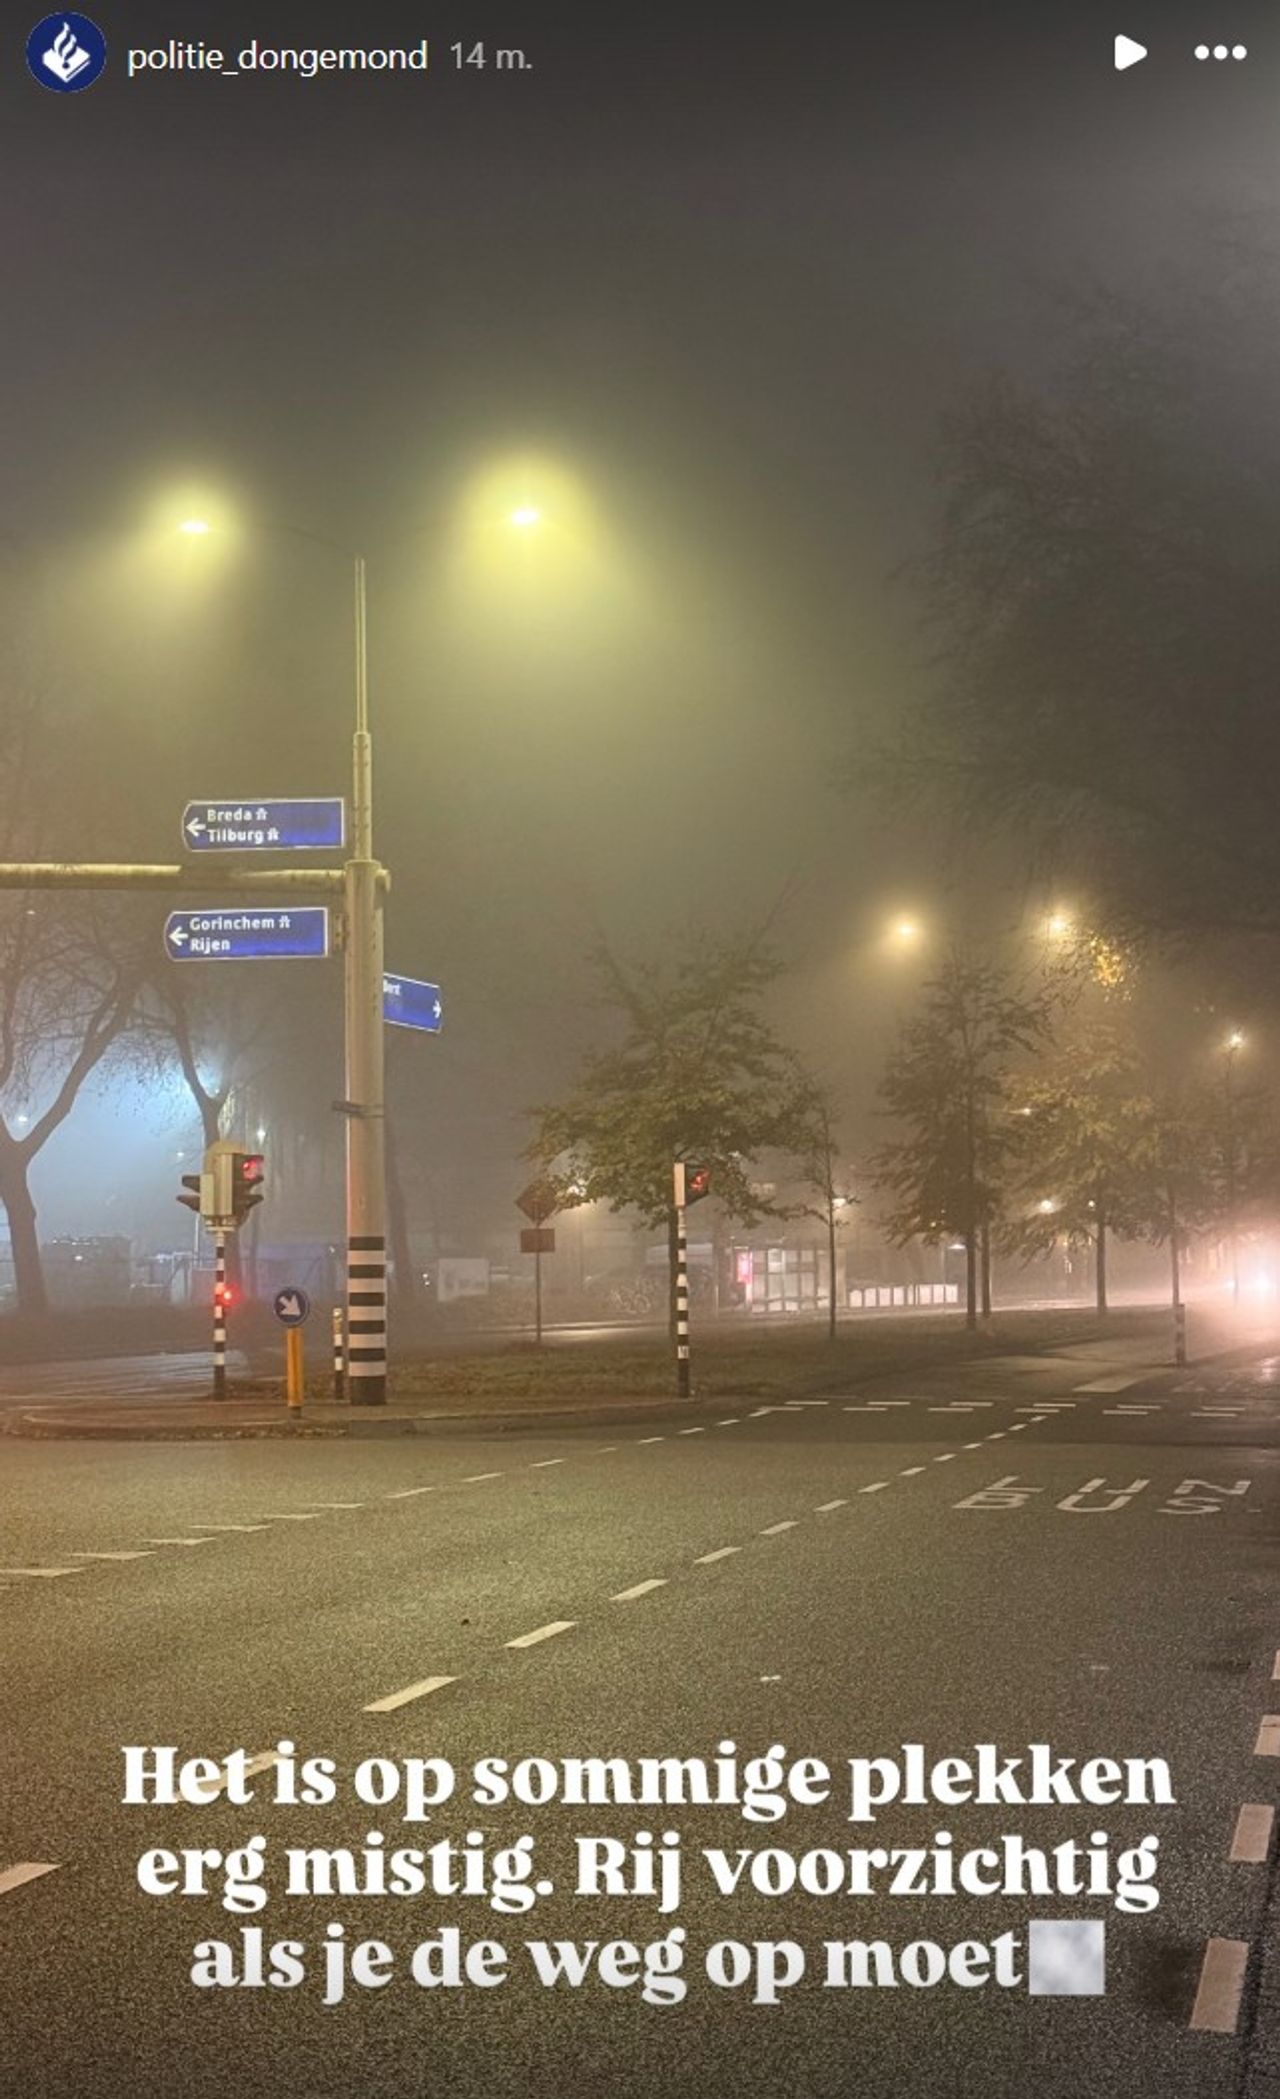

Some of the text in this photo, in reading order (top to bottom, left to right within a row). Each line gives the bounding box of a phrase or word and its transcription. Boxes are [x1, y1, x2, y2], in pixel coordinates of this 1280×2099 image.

[207, 808, 252, 822] Breda
[208, 829, 264, 843] Tilburg
[189, 917, 275, 931] Gorinchem
[189, 938, 231, 954] Rijen
[952, 1490, 1224, 1514] BUS
